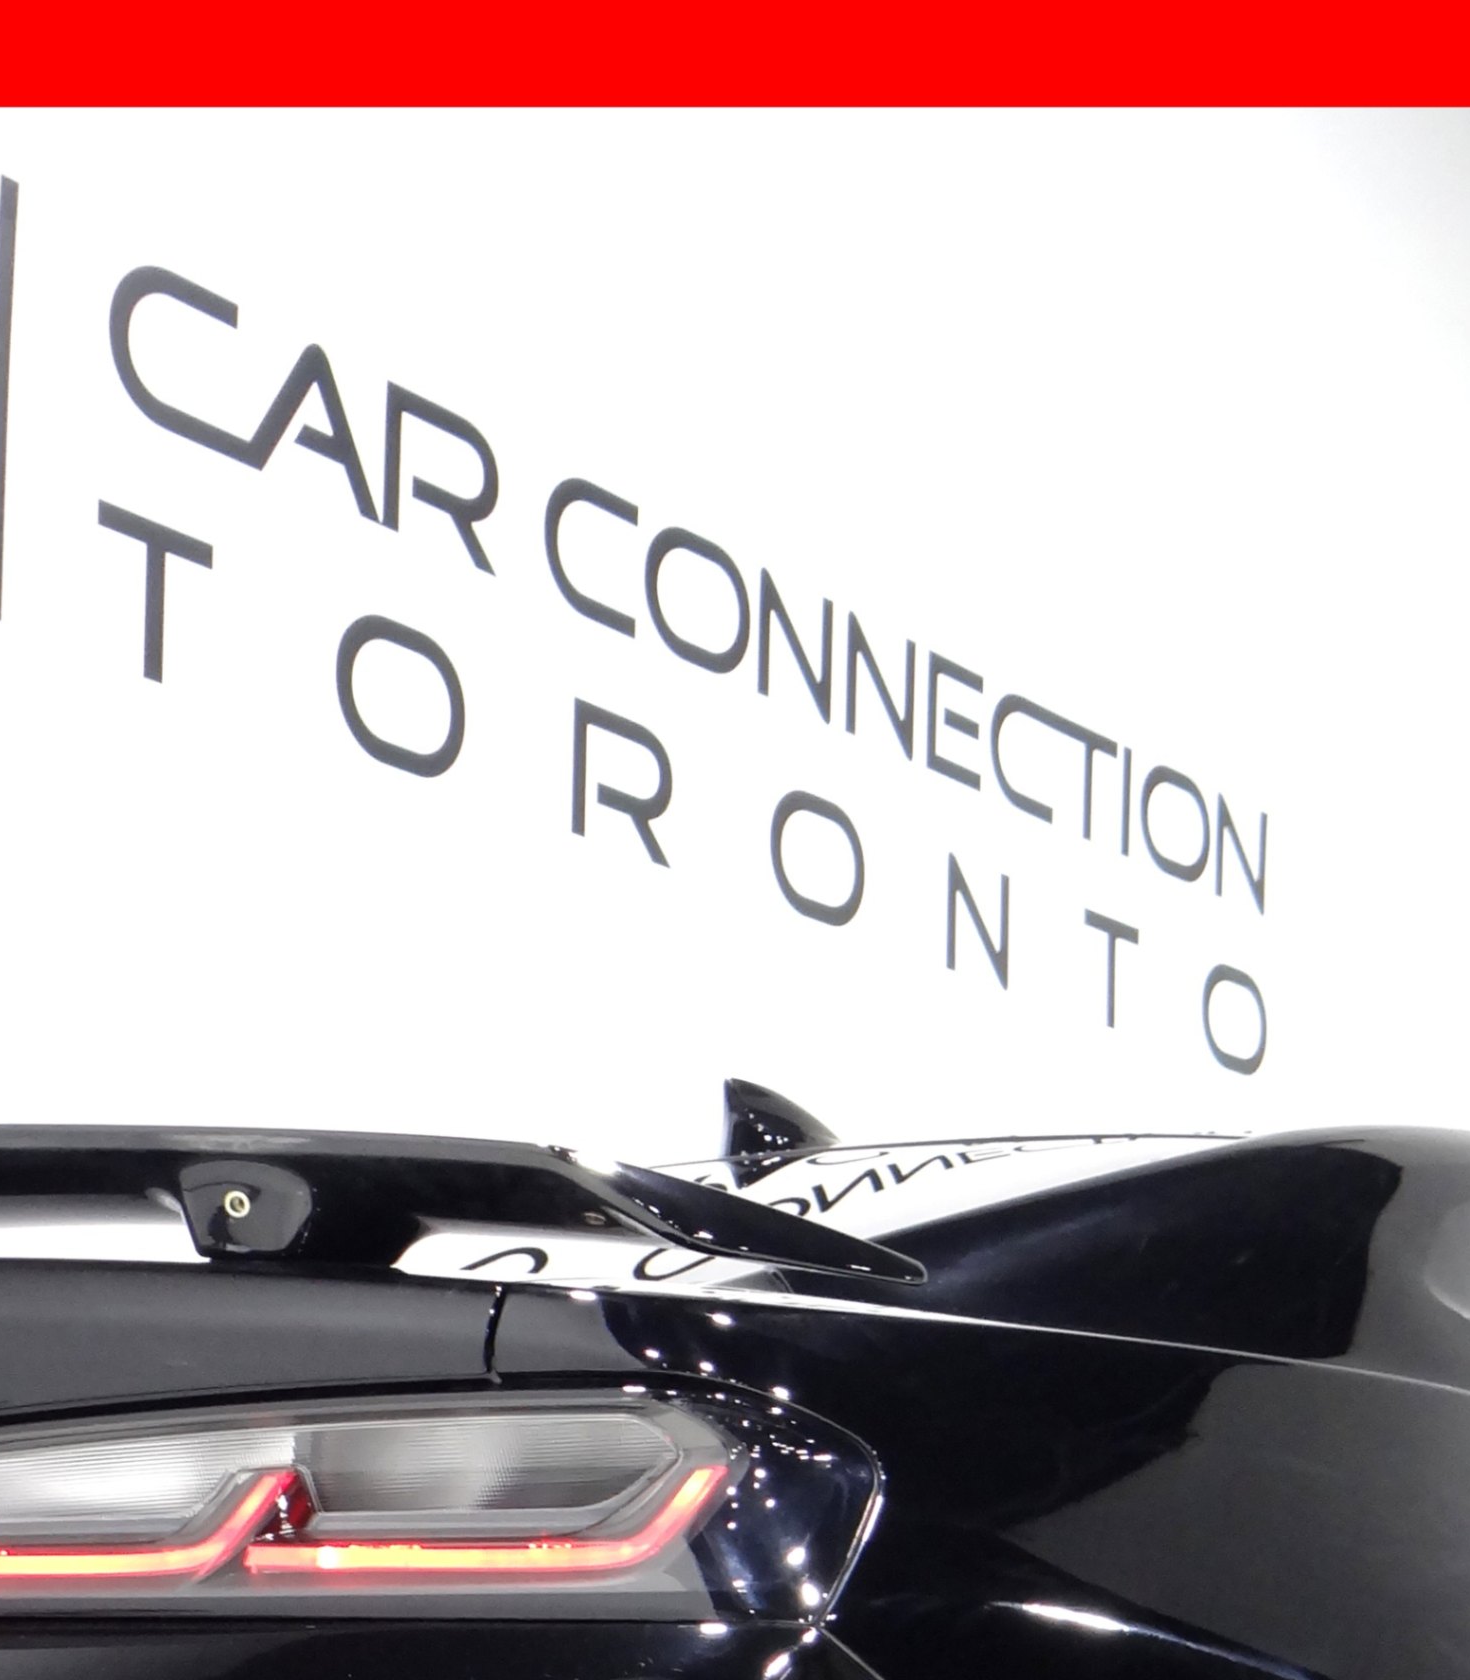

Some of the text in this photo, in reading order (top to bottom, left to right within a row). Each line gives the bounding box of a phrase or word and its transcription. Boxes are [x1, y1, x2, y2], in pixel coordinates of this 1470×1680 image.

[97, 499, 1267, 1077] TORONTO
[107, 264, 499, 577] CAR
[543, 476, 1268, 916] CONNECTION
